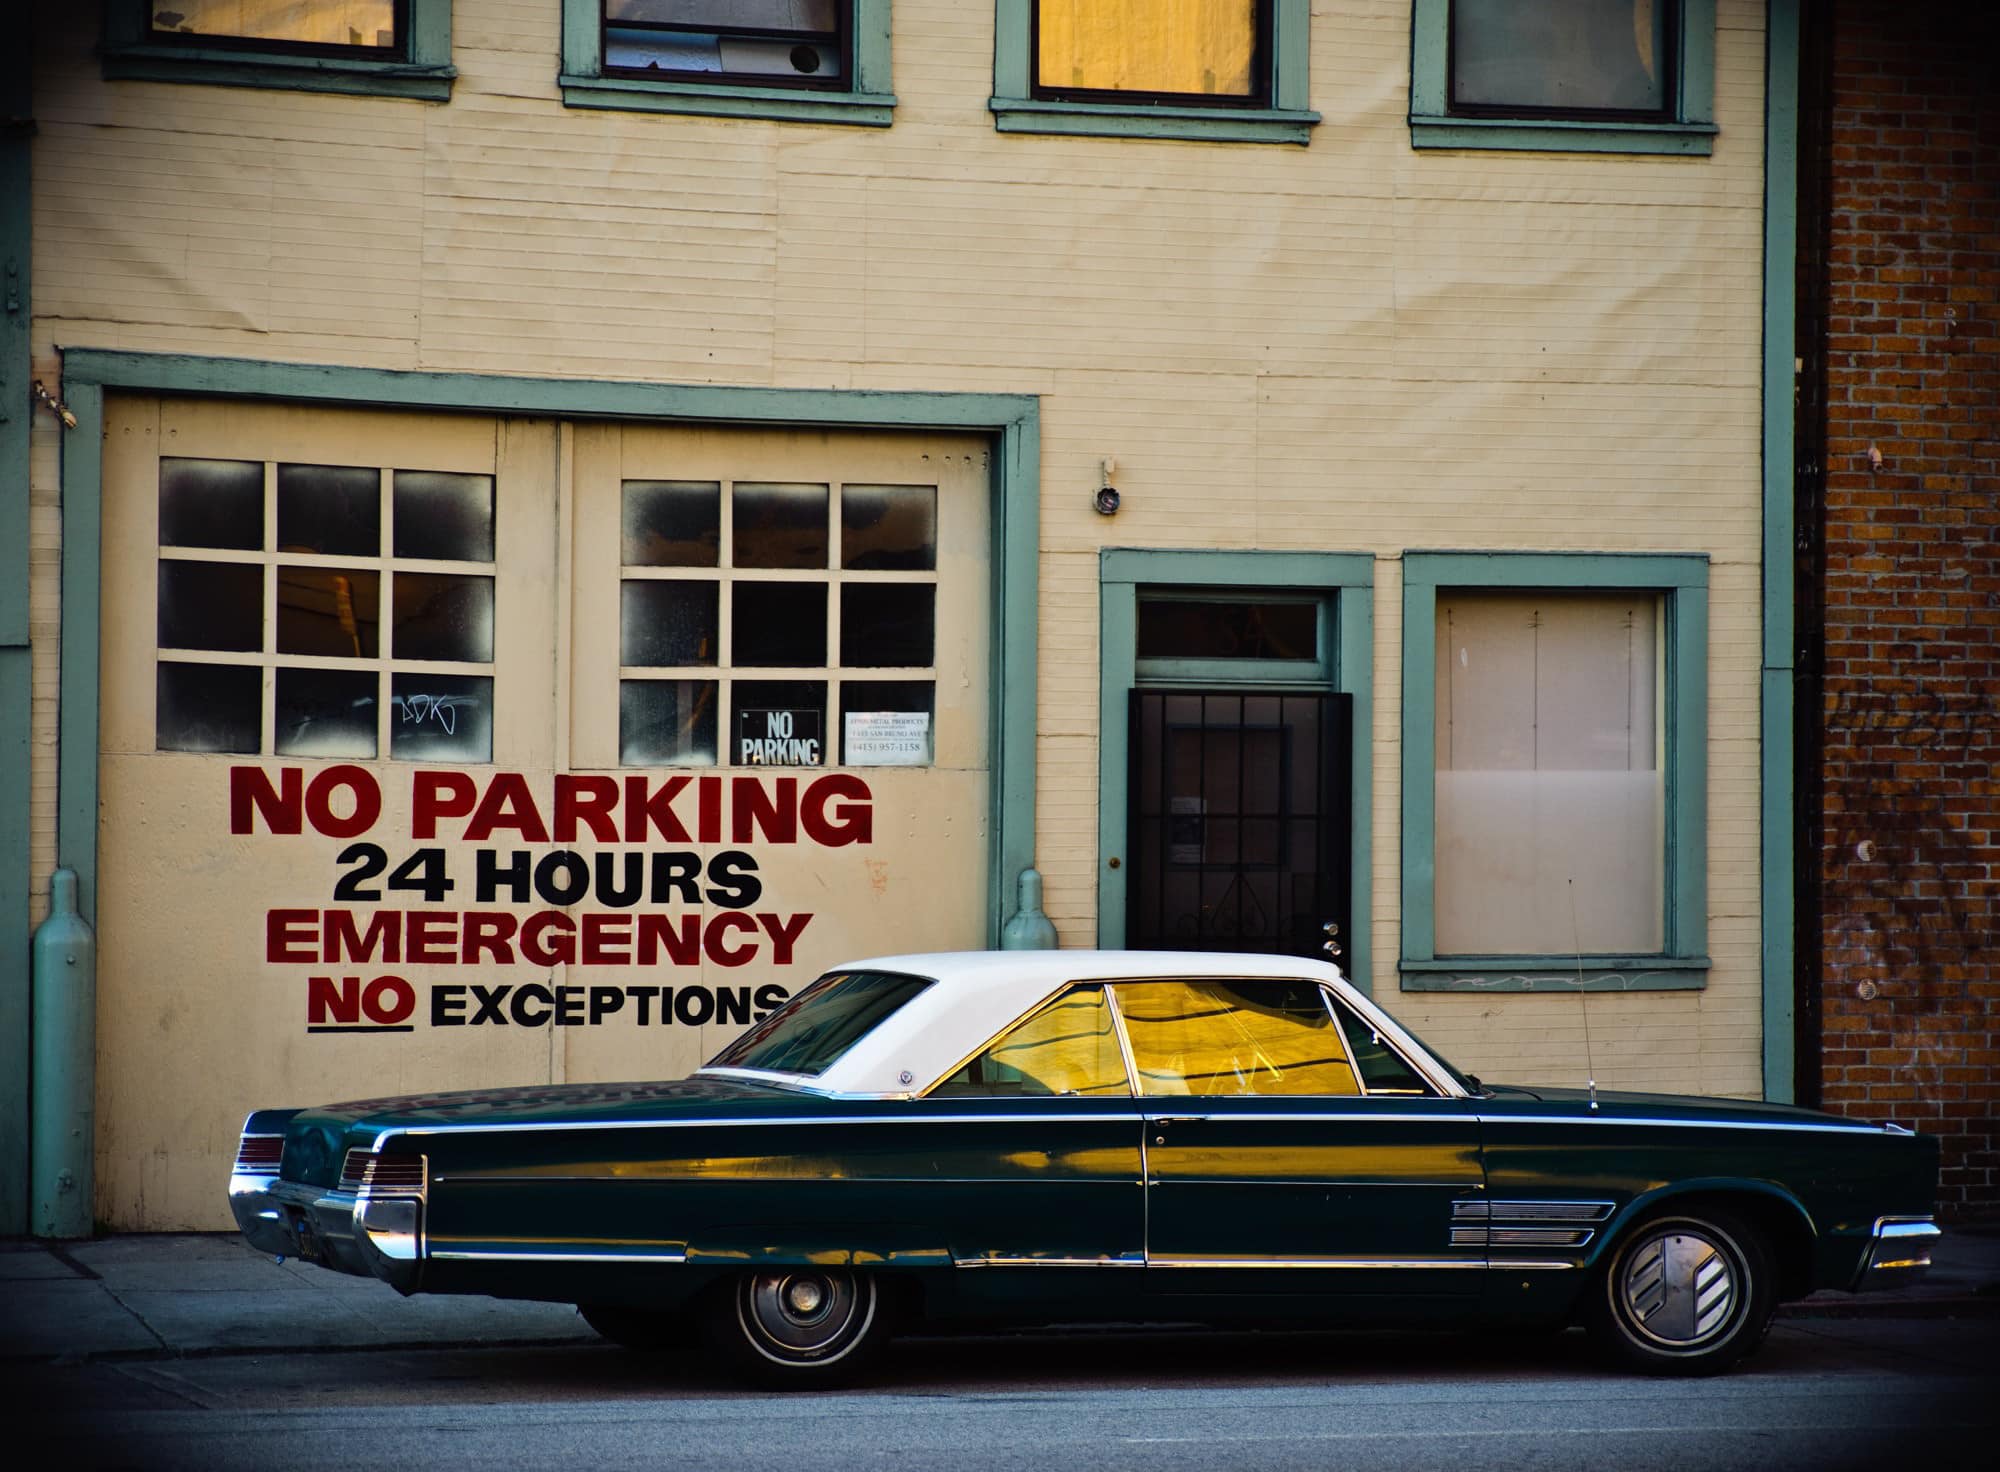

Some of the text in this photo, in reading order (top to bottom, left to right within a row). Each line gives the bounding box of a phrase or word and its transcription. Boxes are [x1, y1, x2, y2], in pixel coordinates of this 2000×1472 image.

[741, 738, 820, 766] PARKING
[767, 711, 793, 739] NO
[231, 765, 872, 847] NO PARKING
[334, 843, 761, 908] 24 HOURS
[267, 910, 813, 967] EMERGENCY
[309, 976, 789, 1027] NO EXCEPTIONS
